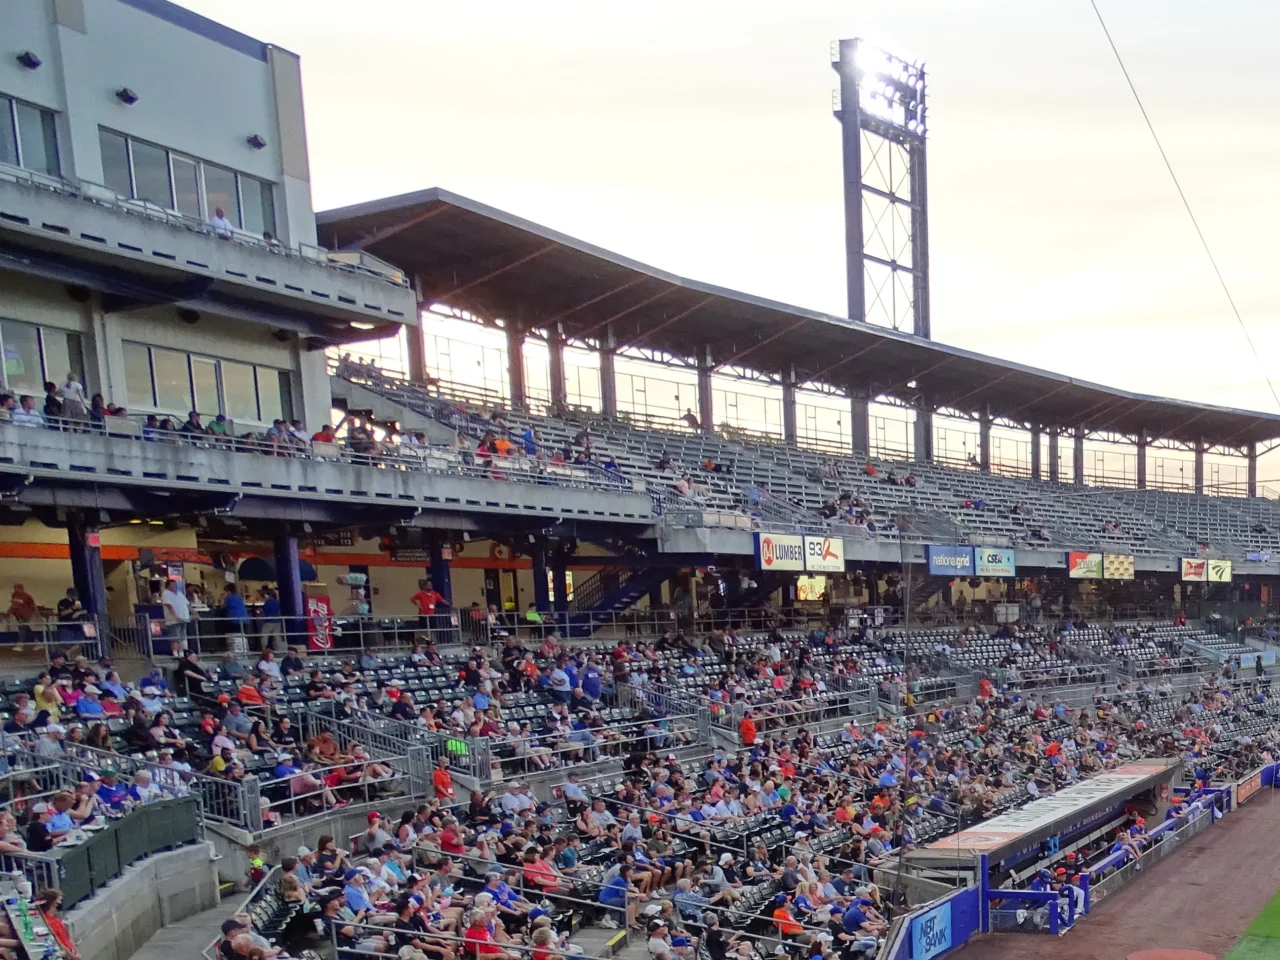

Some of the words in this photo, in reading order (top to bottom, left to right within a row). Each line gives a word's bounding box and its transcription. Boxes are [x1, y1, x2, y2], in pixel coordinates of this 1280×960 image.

[774, 544, 803, 561] LUMBER
[920, 915, 937, 938] NBT
[925, 926, 947, 953] BANK
